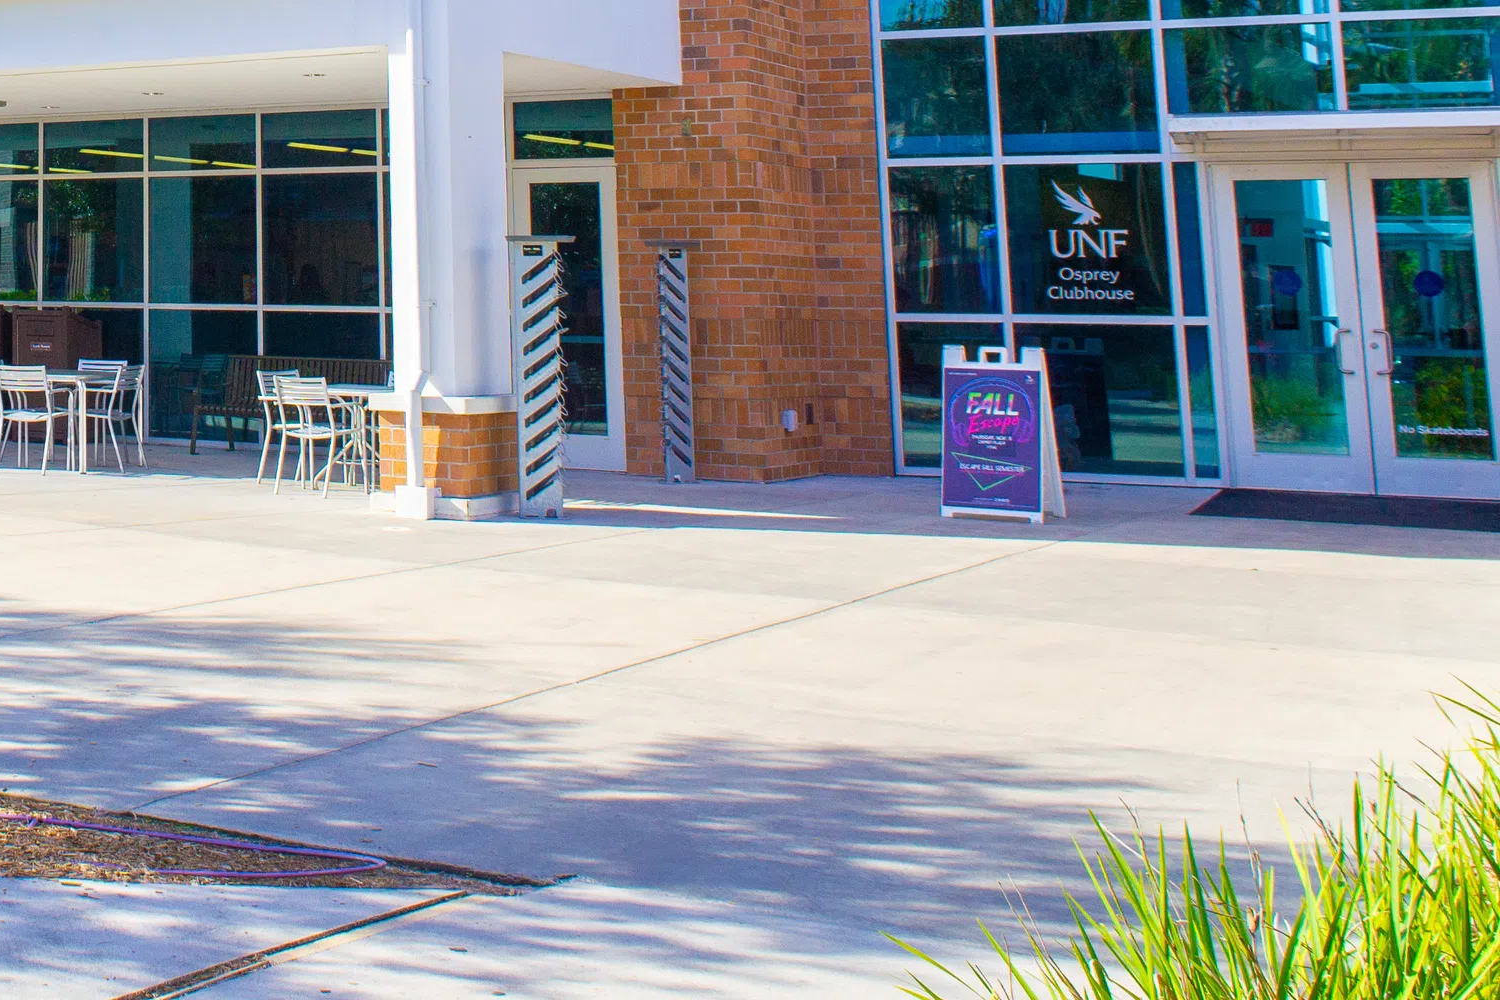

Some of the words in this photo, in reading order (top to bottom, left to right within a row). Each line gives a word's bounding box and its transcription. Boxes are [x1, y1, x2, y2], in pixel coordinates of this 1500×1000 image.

[1048, 229, 1129, 258] UNF
[1058, 267, 1121, 285] Osprey
[1047, 285, 1136, 300] Clubhouse
[966, 391, 1019, 416] FALL
[966, 414, 1020, 434] Escape
[1397, 425, 1416, 434] No
[1417, 425, 1490, 436] Skateboards
[994, 464, 1025, 473] SEMESTER
